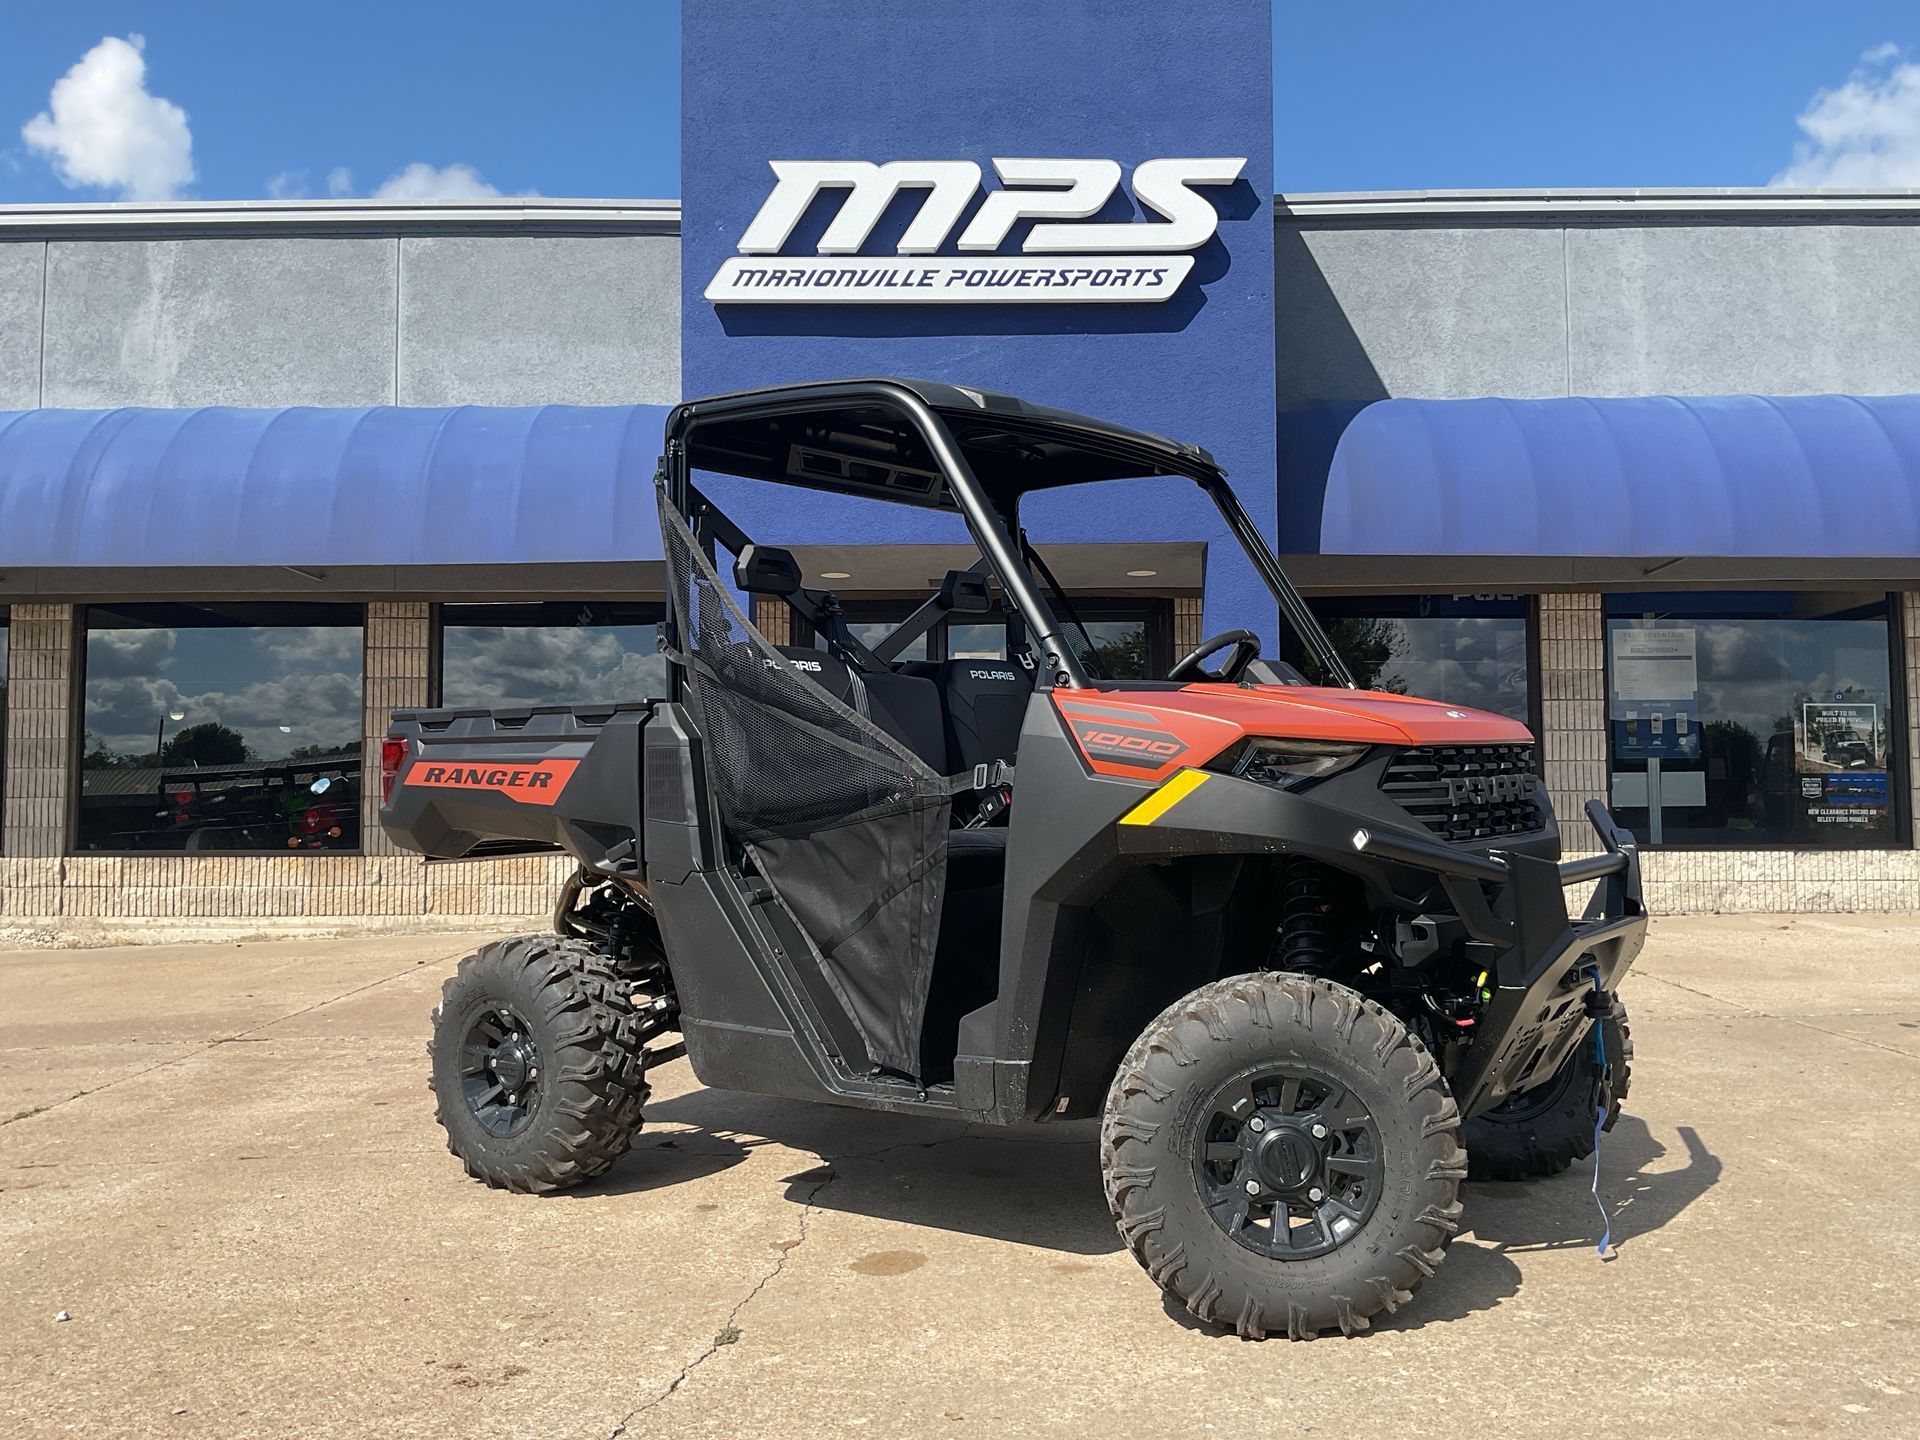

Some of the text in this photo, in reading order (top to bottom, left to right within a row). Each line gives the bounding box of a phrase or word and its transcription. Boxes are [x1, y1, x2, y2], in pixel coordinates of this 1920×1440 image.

[736, 157, 1248, 254] MPS
[732, 267, 1170, 288] MARIONVILLE POWERSPORTS
[970, 670, 1016, 681] POLARIS
[1083, 731, 1180, 755] 1000
[423, 766, 554, 789] RANGER
